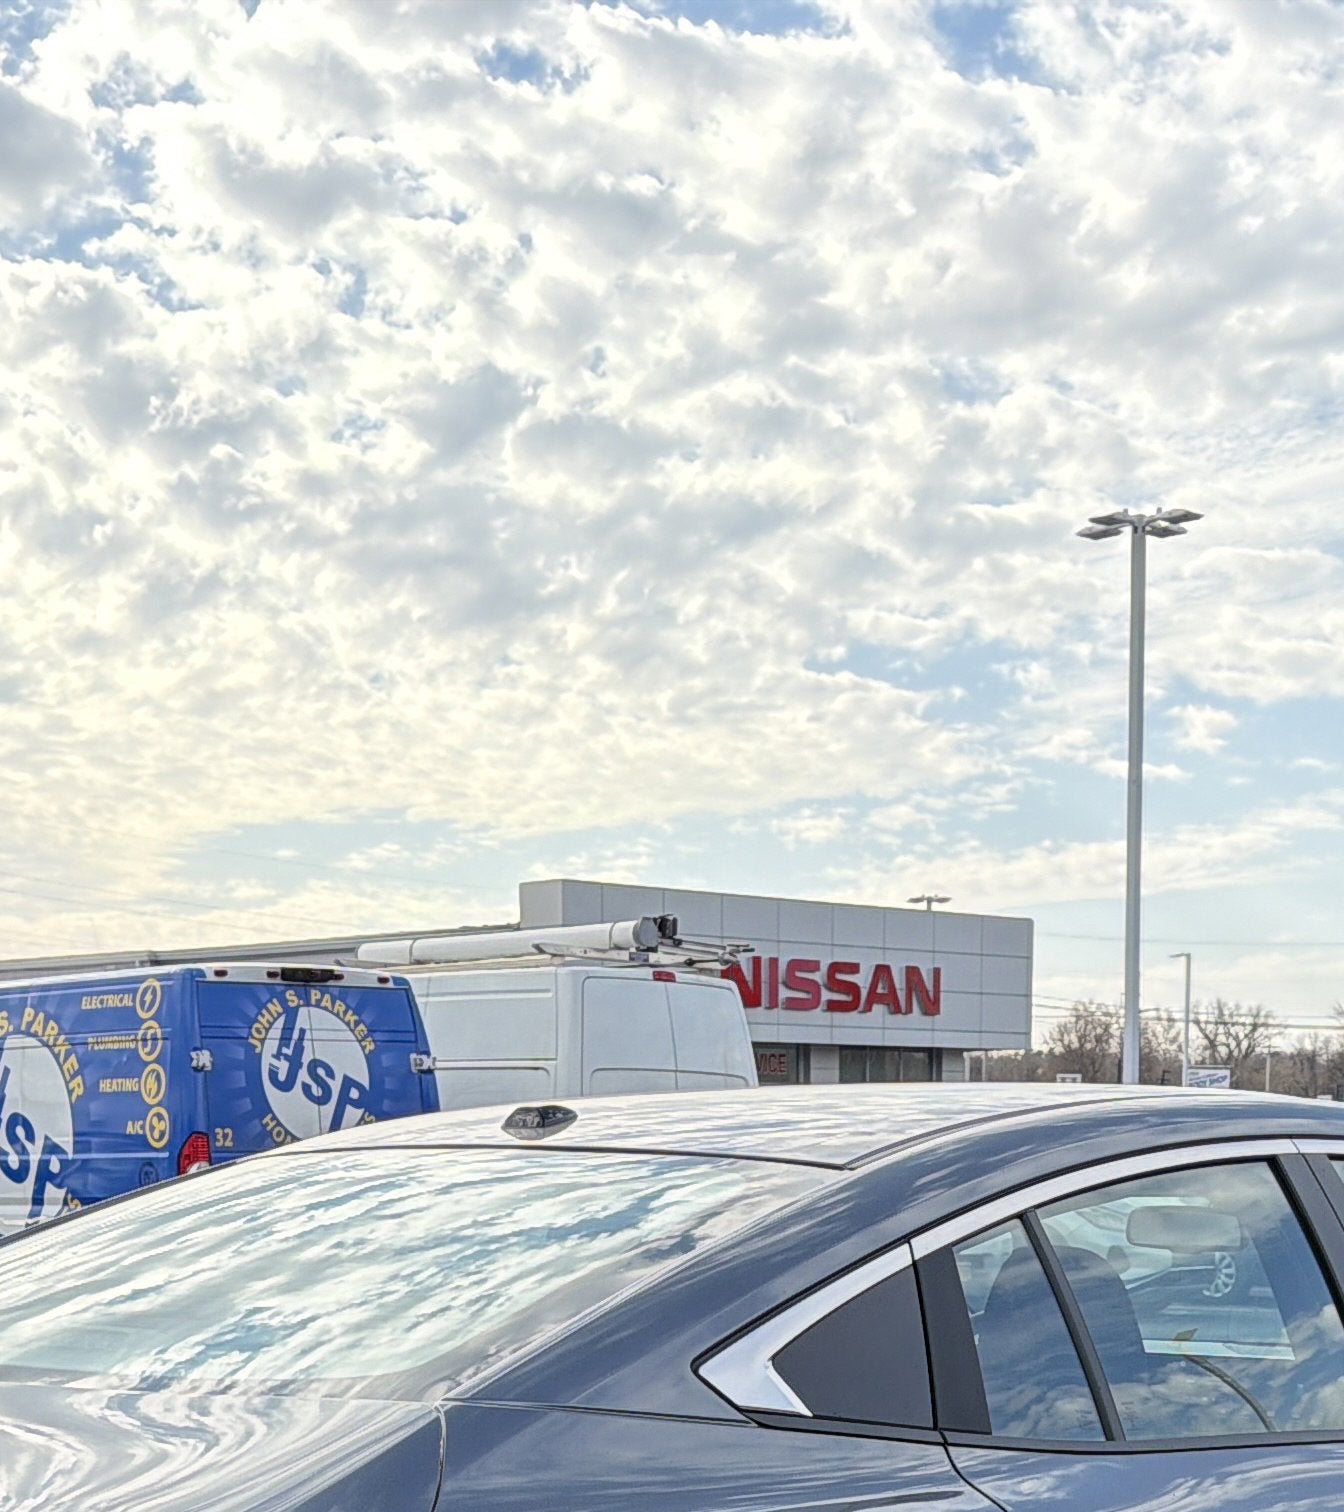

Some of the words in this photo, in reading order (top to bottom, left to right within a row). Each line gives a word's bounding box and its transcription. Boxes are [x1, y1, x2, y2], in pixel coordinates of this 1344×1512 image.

[720, 955, 942, 1017] NISSAN
[81, 995, 134, 1011] ELECTRICAL
[248, 998, 284, 1054] JOHN
[285, 989, 304, 1008] S.
[311, 989, 377, 1055] PARKER
[87, 1035, 137, 1051] PLUMBING
[20, 1007, 85, 1104] PARKER
[99, 1078, 139, 1093] HEATING
[126, 1120, 143, 1136] A/C
[214, 1128, 234, 1147] 32
